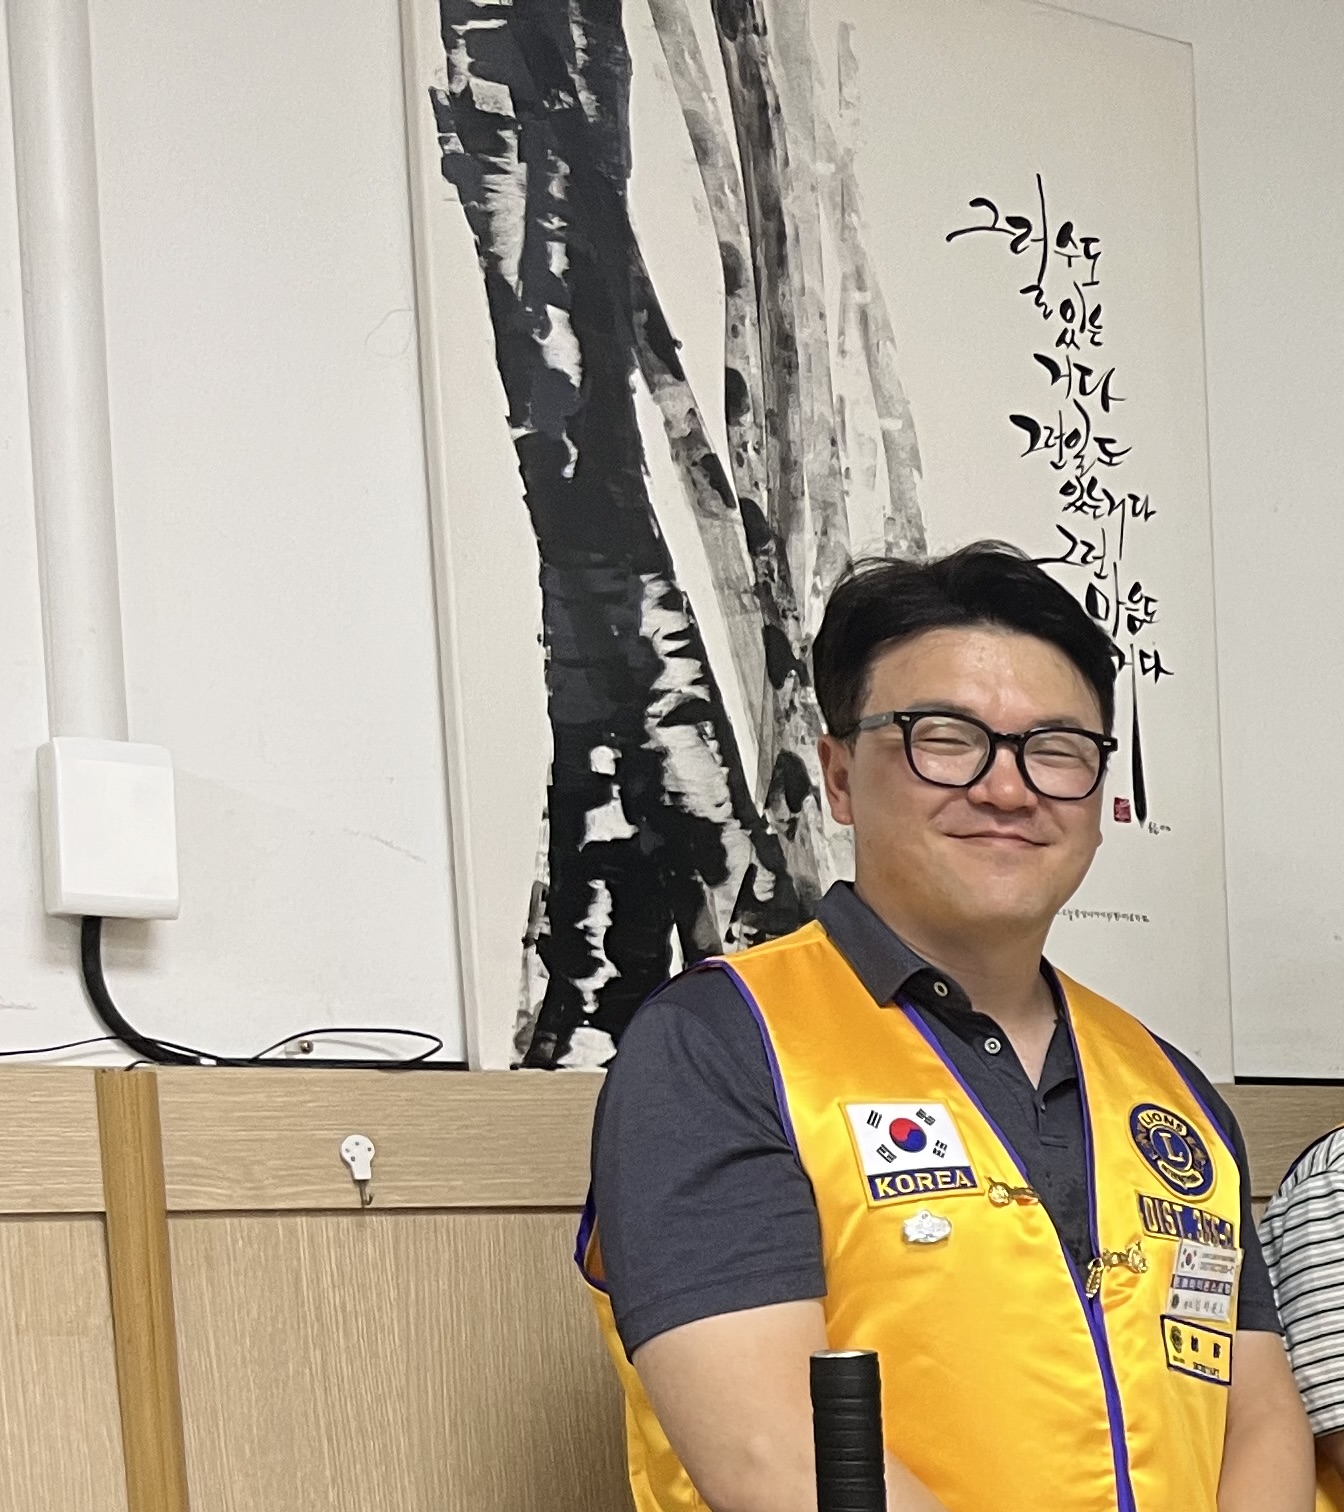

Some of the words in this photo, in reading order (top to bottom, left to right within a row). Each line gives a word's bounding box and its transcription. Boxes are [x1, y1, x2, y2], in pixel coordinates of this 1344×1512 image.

[1033, 354, 1127, 414] 거다
[1140, 1112, 1184, 1133] LIONS
[1158, 1132, 1185, 1162] L
[874, 1169, 972, 1198] KOREA
